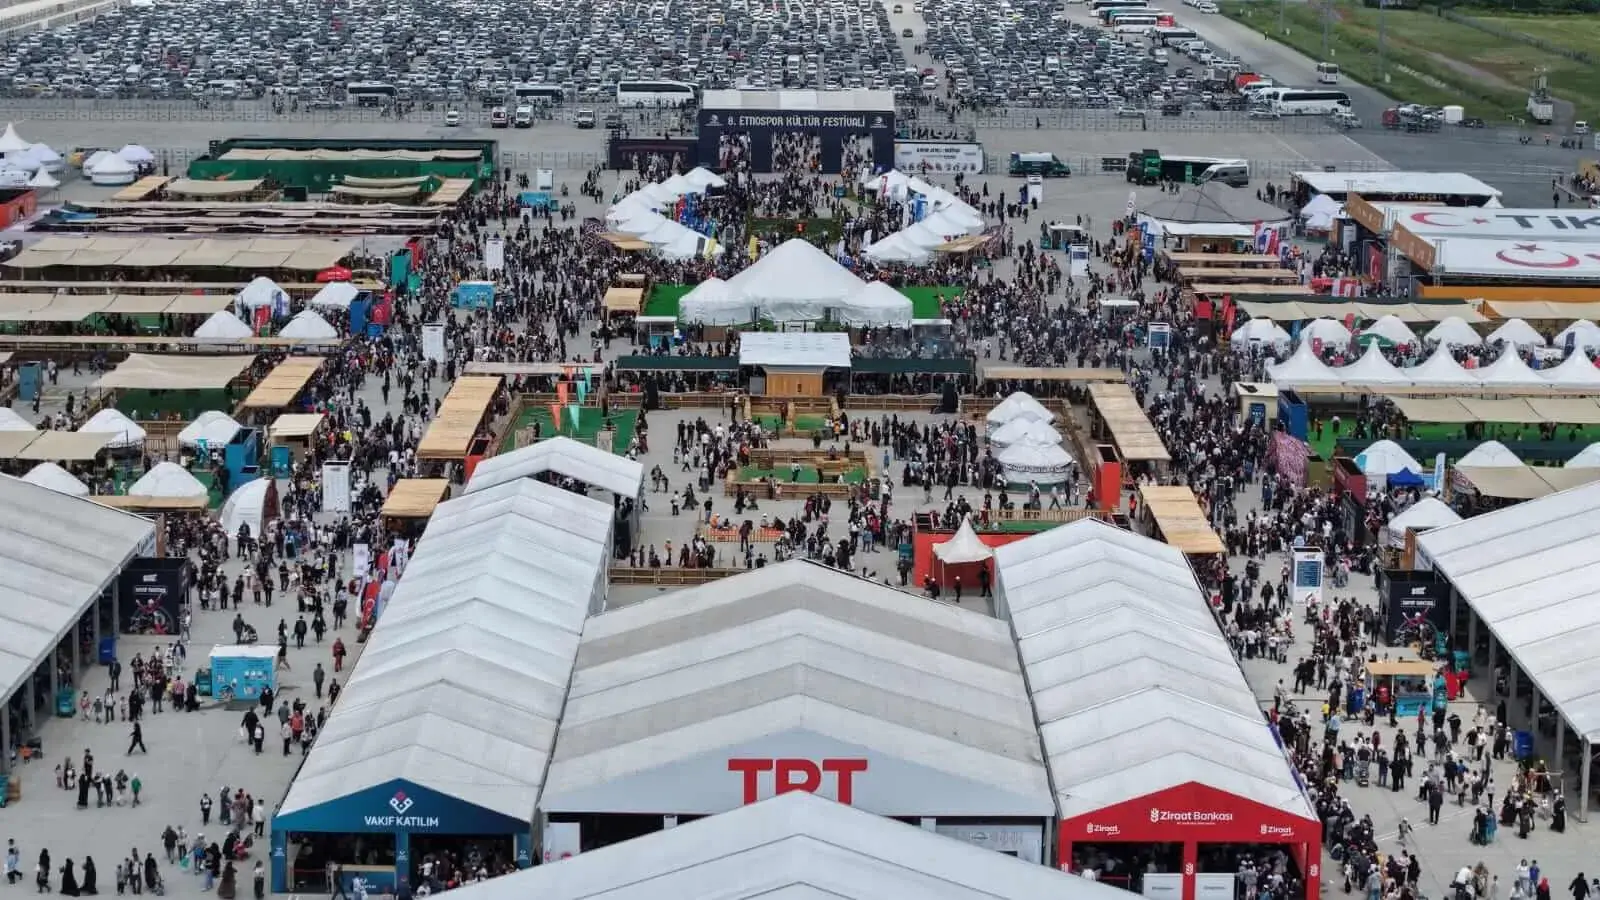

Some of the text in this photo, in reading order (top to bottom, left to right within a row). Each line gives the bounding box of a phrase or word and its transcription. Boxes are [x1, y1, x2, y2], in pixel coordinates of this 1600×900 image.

[785, 114, 821, 127] KÜLTÜR
[728, 759, 868, 806] TRT
[364, 815, 439, 828] VAKIF KATILIM
[1159, 811, 1234, 822] Ziraat Bankası
